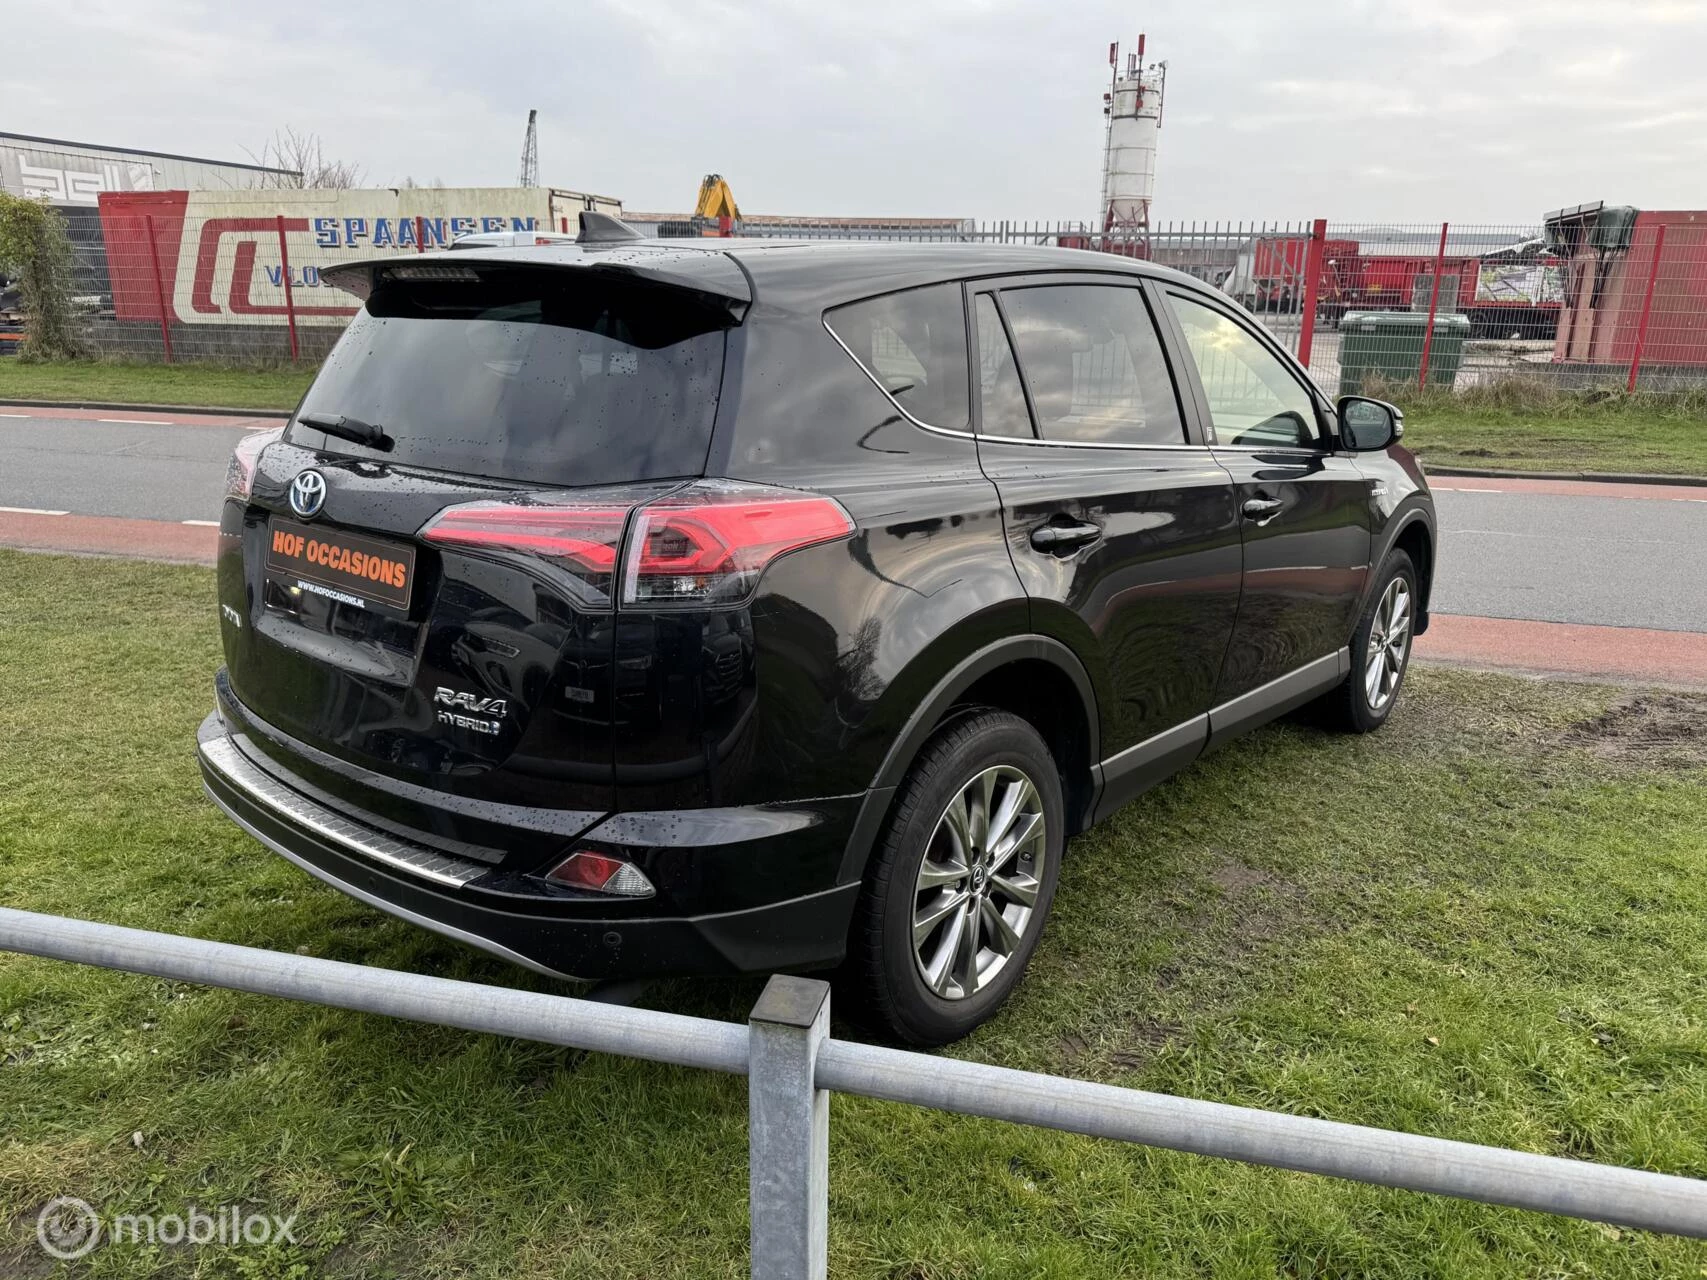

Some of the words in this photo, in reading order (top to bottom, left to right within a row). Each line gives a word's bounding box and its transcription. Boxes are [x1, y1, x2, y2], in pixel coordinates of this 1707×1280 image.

[264, 265, 333, 287] VLO
[272, 530, 305, 558] HOF
[306, 539, 406, 588] OCCASIONS
[297, 579, 365, 608] WWW.HOFOCCASIONS.NL
[433, 686, 508, 719] RAV4
[437, 710, 490, 734] HYBRID
